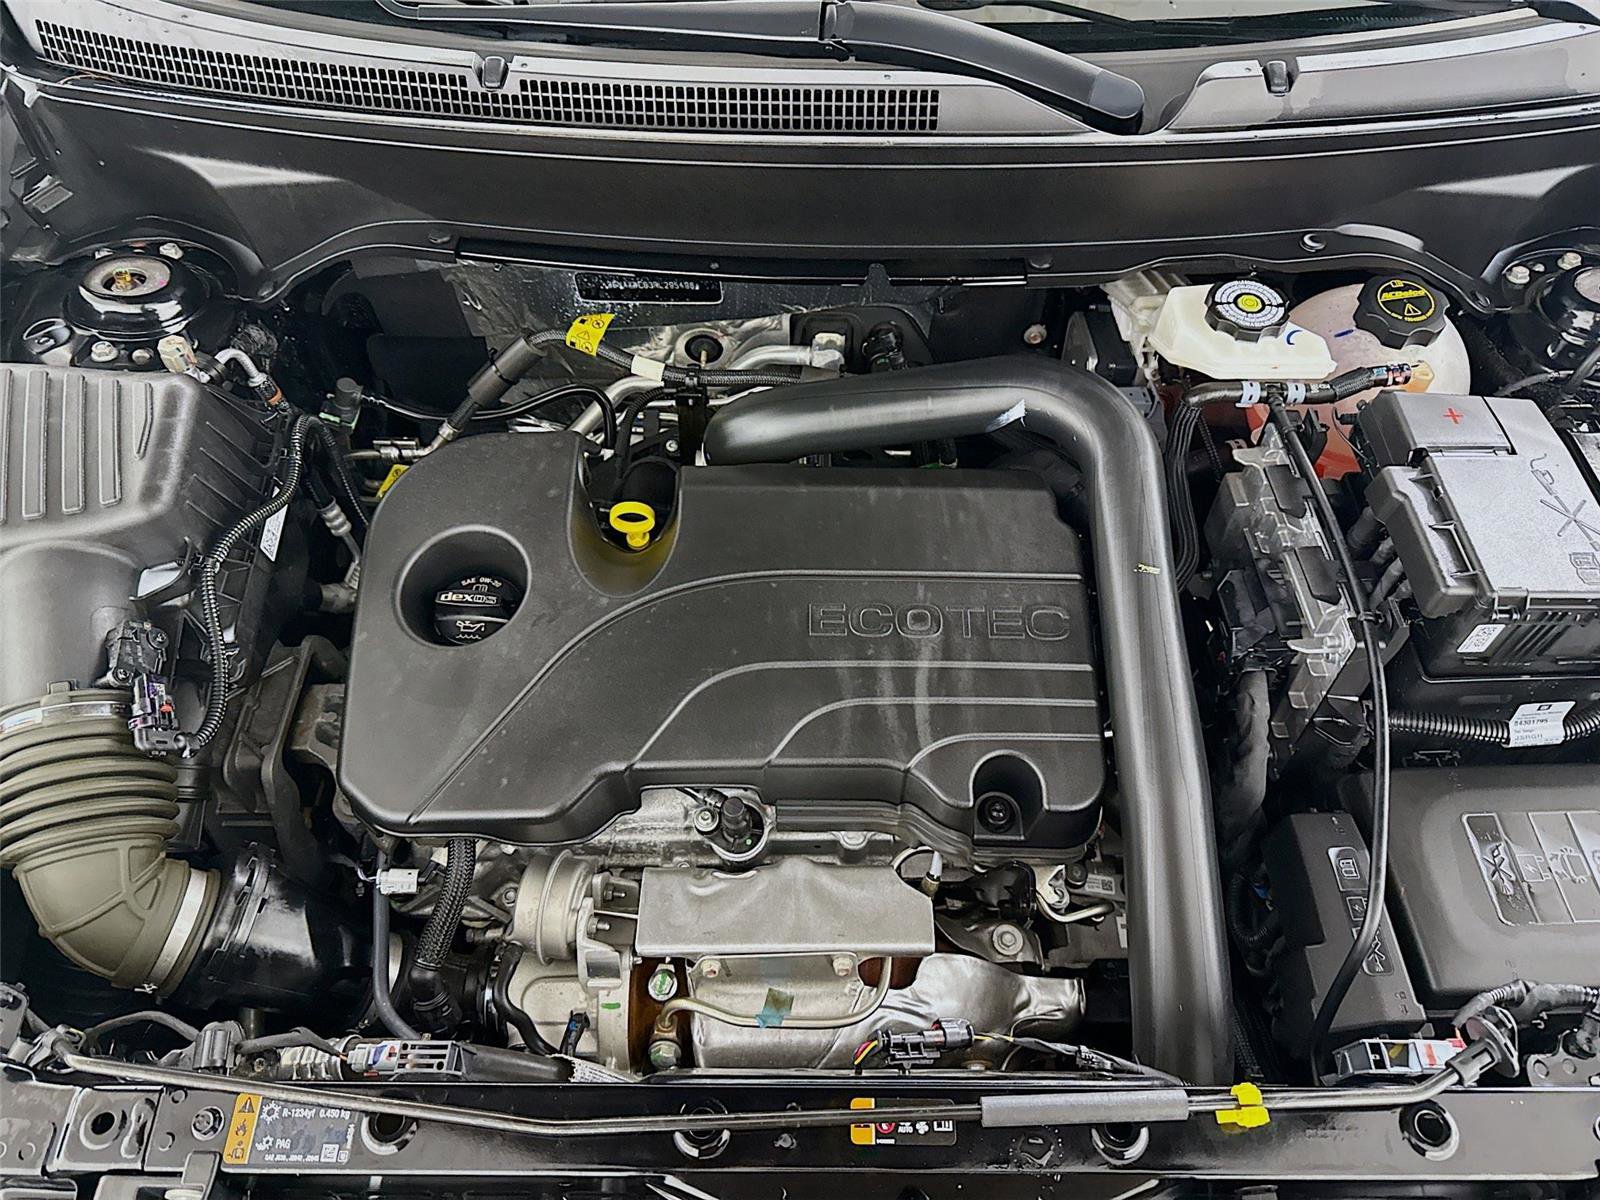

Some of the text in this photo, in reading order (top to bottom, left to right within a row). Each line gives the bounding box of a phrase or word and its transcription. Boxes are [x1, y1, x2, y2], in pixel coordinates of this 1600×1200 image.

[461, 577, 476, 586] SAE
[440, 591, 497, 604] dexos
[808, 603, 1070, 641] ECOTEC
[282, 1108, 351, 1120] R-1234yf 0.450 kg
[897, 1125, 914, 1133] AUTO
[275, 1138, 291, 1149] PAG
